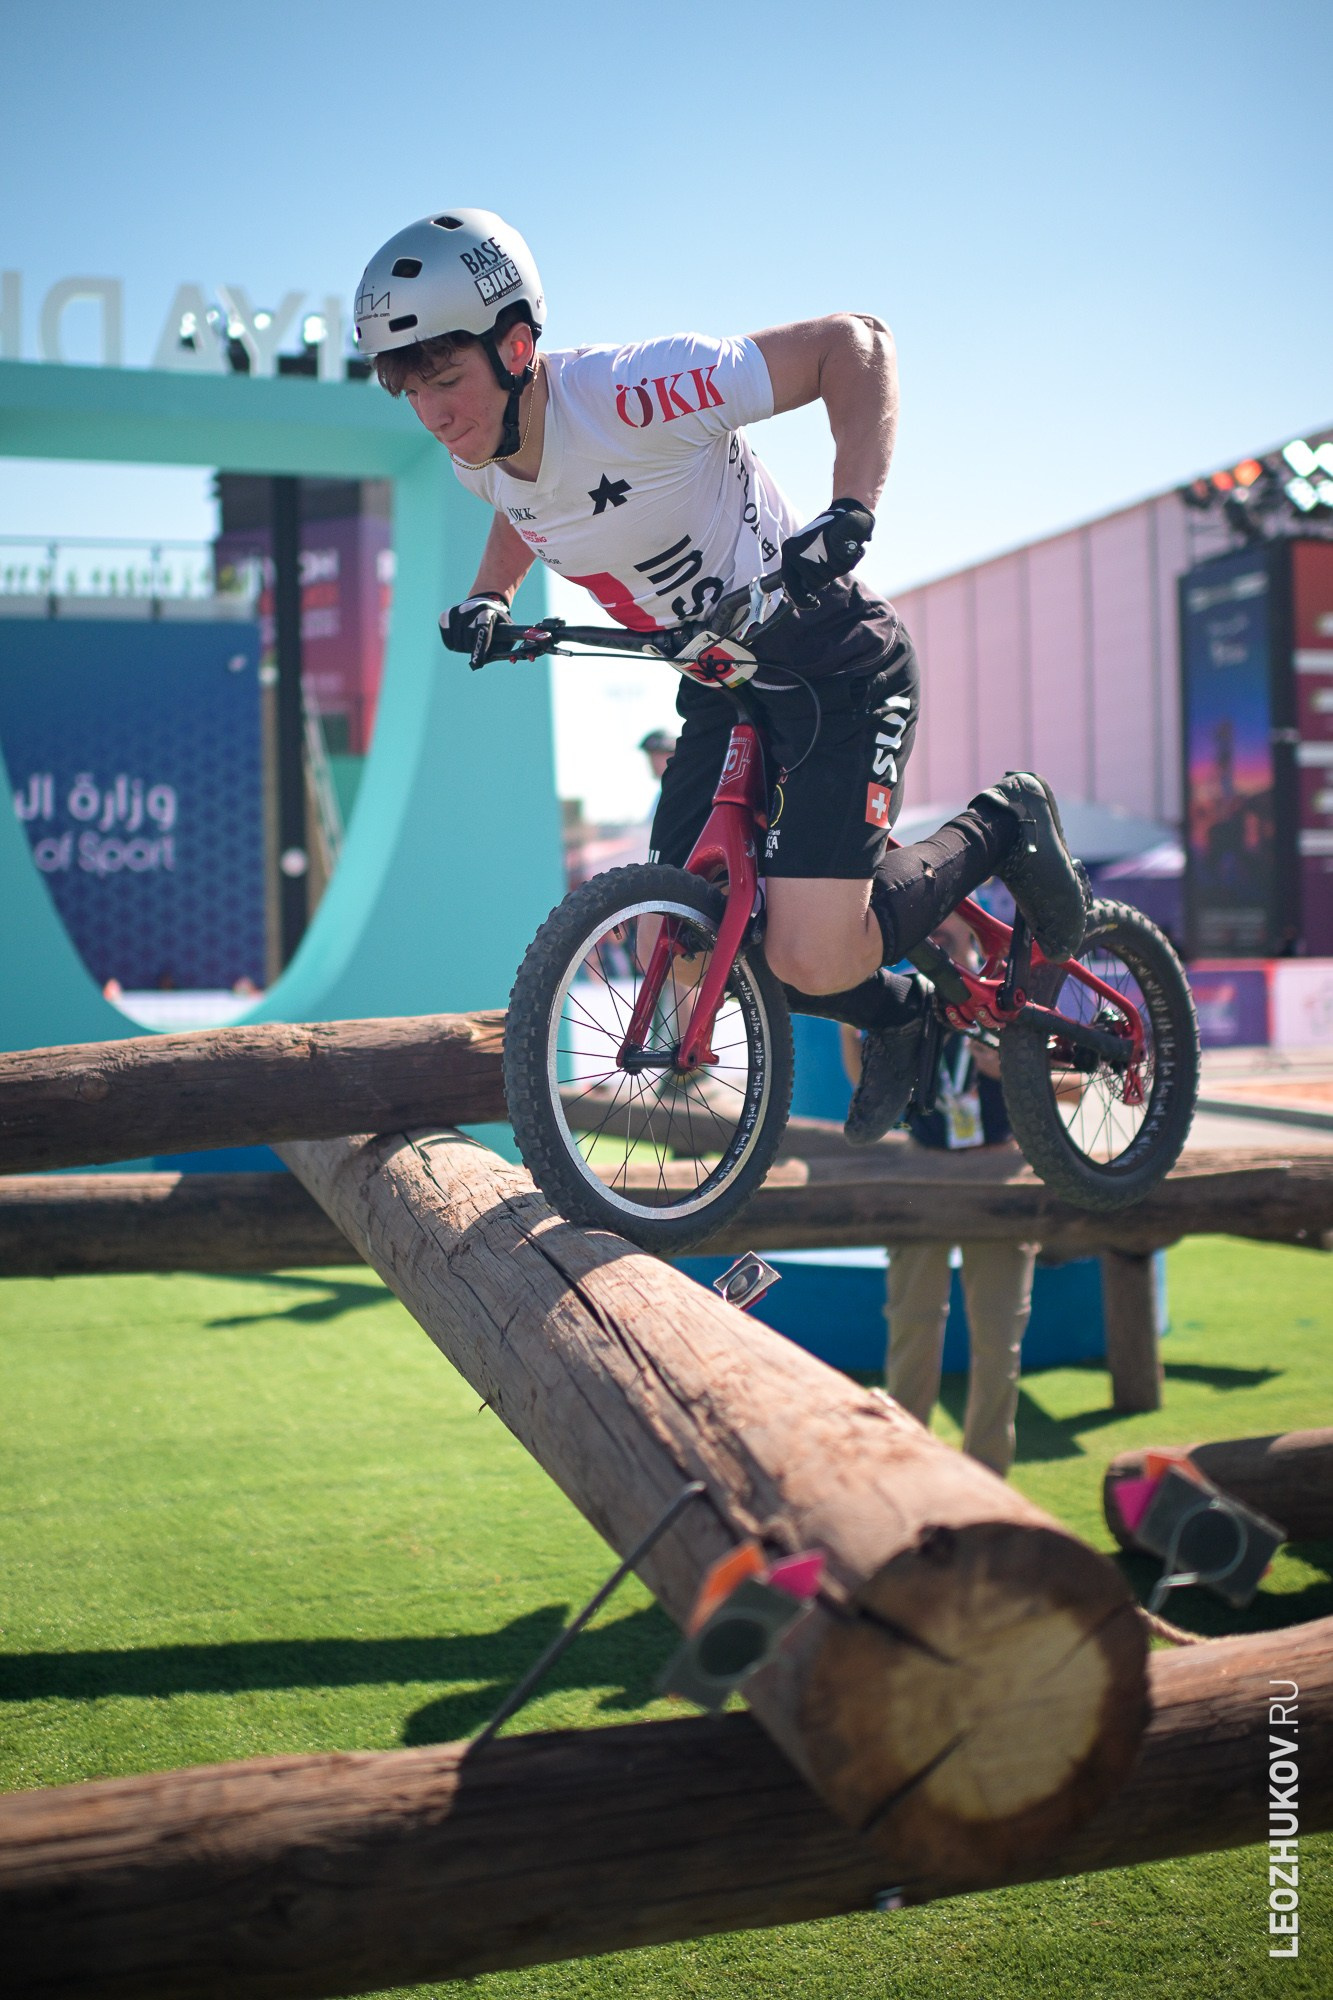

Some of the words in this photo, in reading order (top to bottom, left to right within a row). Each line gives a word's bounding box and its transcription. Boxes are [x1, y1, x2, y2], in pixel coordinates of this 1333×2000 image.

[460, 236, 507, 276] BASE
[476, 262, 521, 300] BIKE
[616, 364, 726, 428] ÖKK
[633, 534, 725, 621] SUI
[872, 695, 911, 783] SUI
